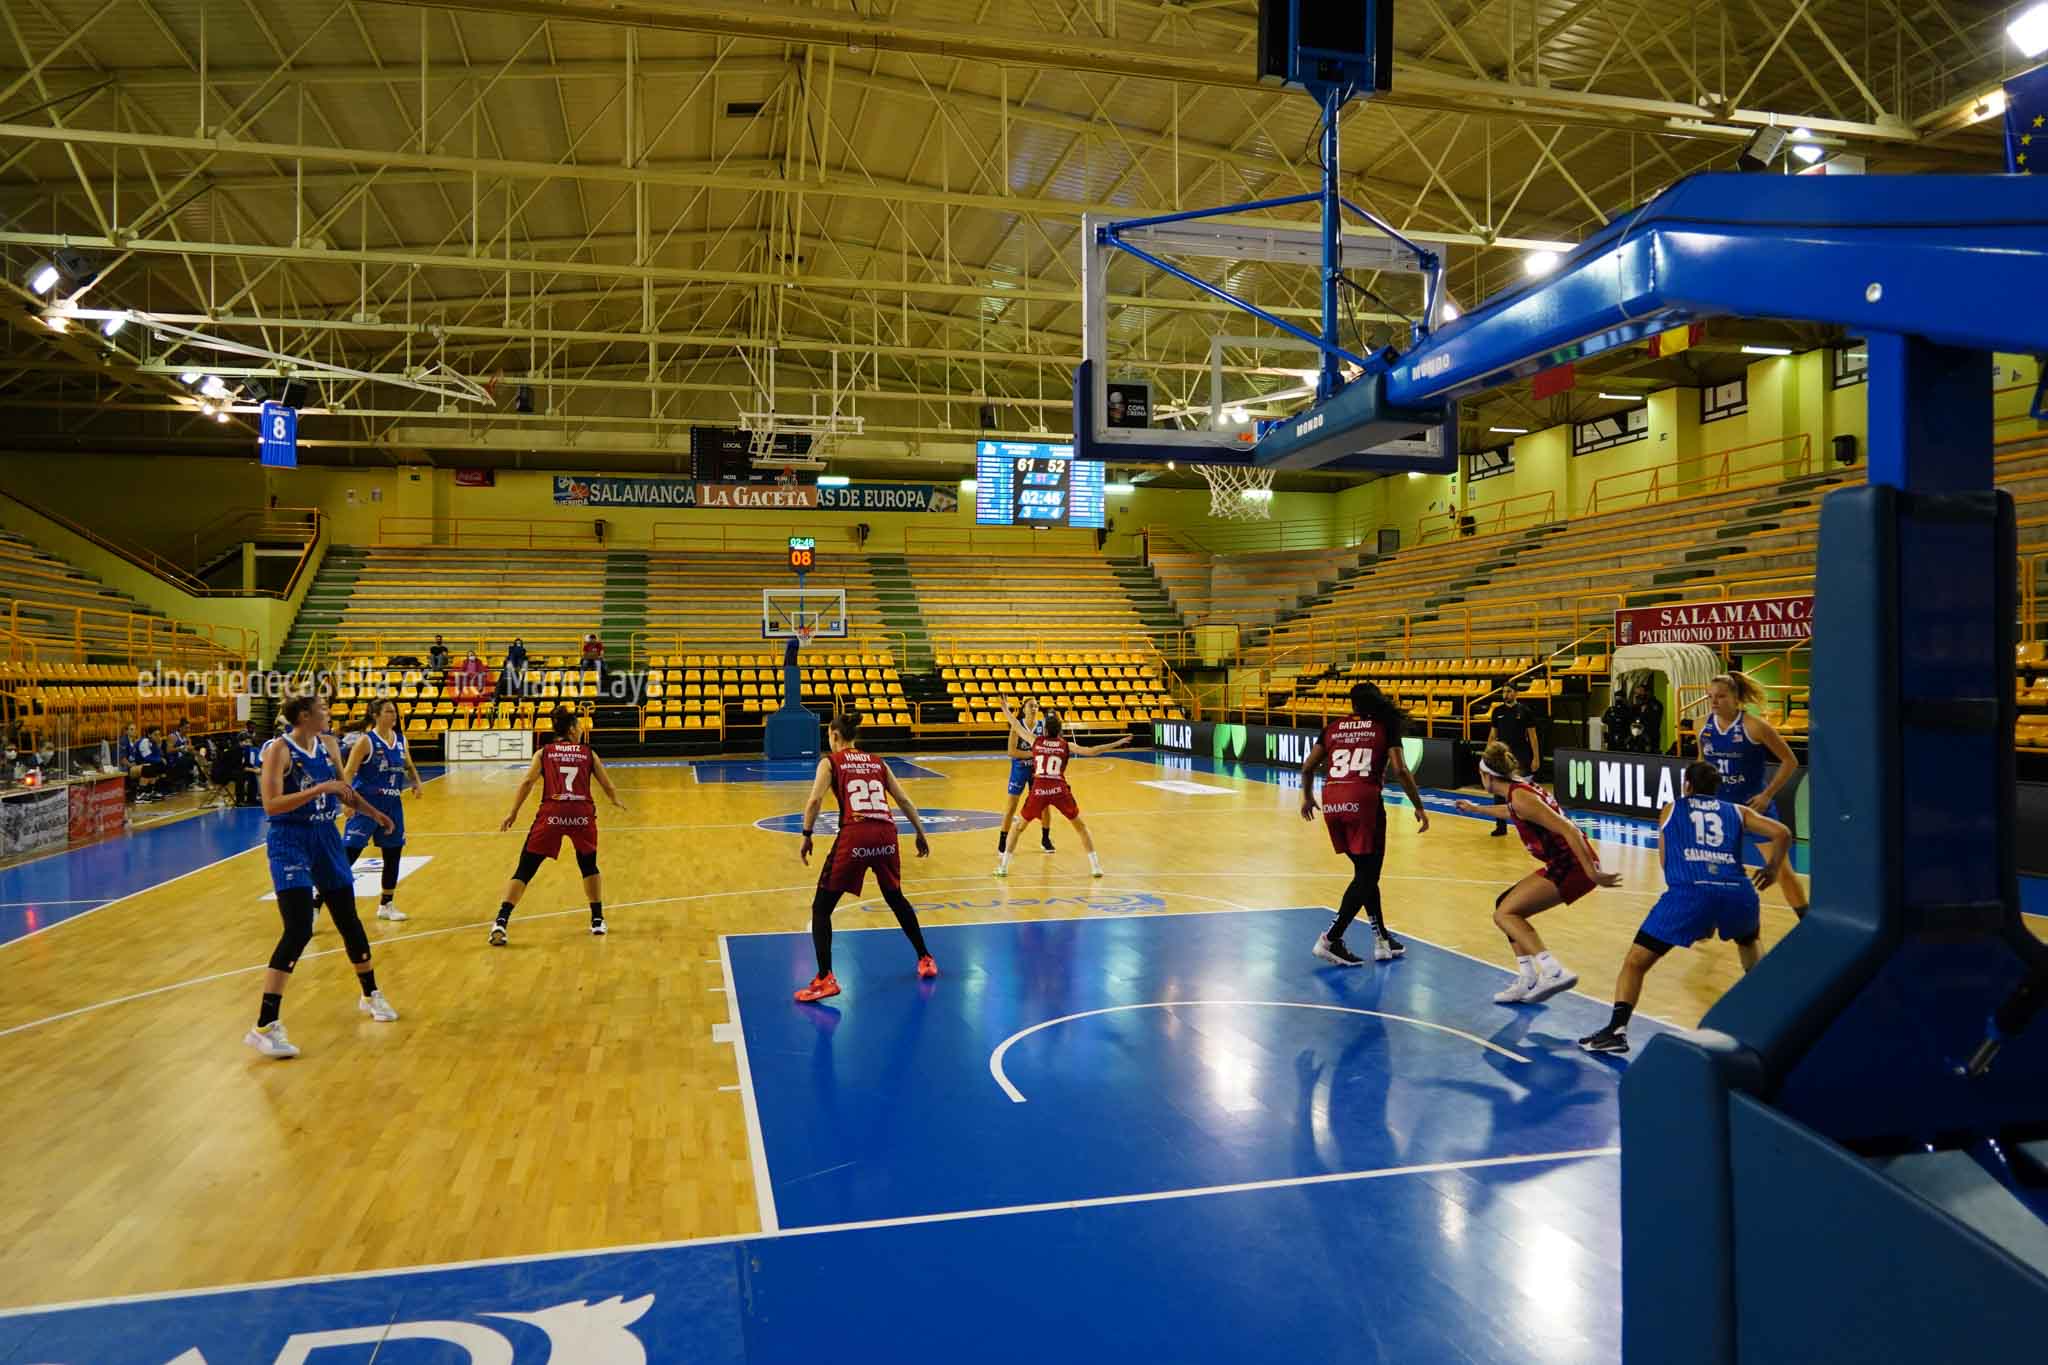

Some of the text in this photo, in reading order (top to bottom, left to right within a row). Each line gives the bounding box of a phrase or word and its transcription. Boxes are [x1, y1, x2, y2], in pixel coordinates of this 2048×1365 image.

[1412, 354, 1450, 381] MONDO
[273, 416, 286, 439] 8
[1296, 413, 1324, 438] MONDO
[1017, 458, 1066, 473] 61 52
[589, 484, 696, 504] SALAMANCA
[840, 491, 859, 507] DE
[865, 490, 926, 508] EUROPA
[791, 551, 811, 565] 08
[1639, 627, 1713, 644] PATRIMONIO
[1717, 625, 1735, 641] DE
[1739, 624, 1756, 640] LA
[1163, 723, 1192, 750] MILAR
[1339, 720, 1372, 730] GATLING
[1034, 754, 1062, 775] 10
[1329, 747, 1373, 778] 34
[559, 766, 579, 793] 7
[1599, 760, 1687, 810] MILA
[847, 779, 889, 812] 22
[1323, 802, 1360, 814] OMMOS
[547, 816, 589, 826] SOMMOS
[1690, 810, 1724, 848] 13
[851, 844, 896, 858] SOMMOS
